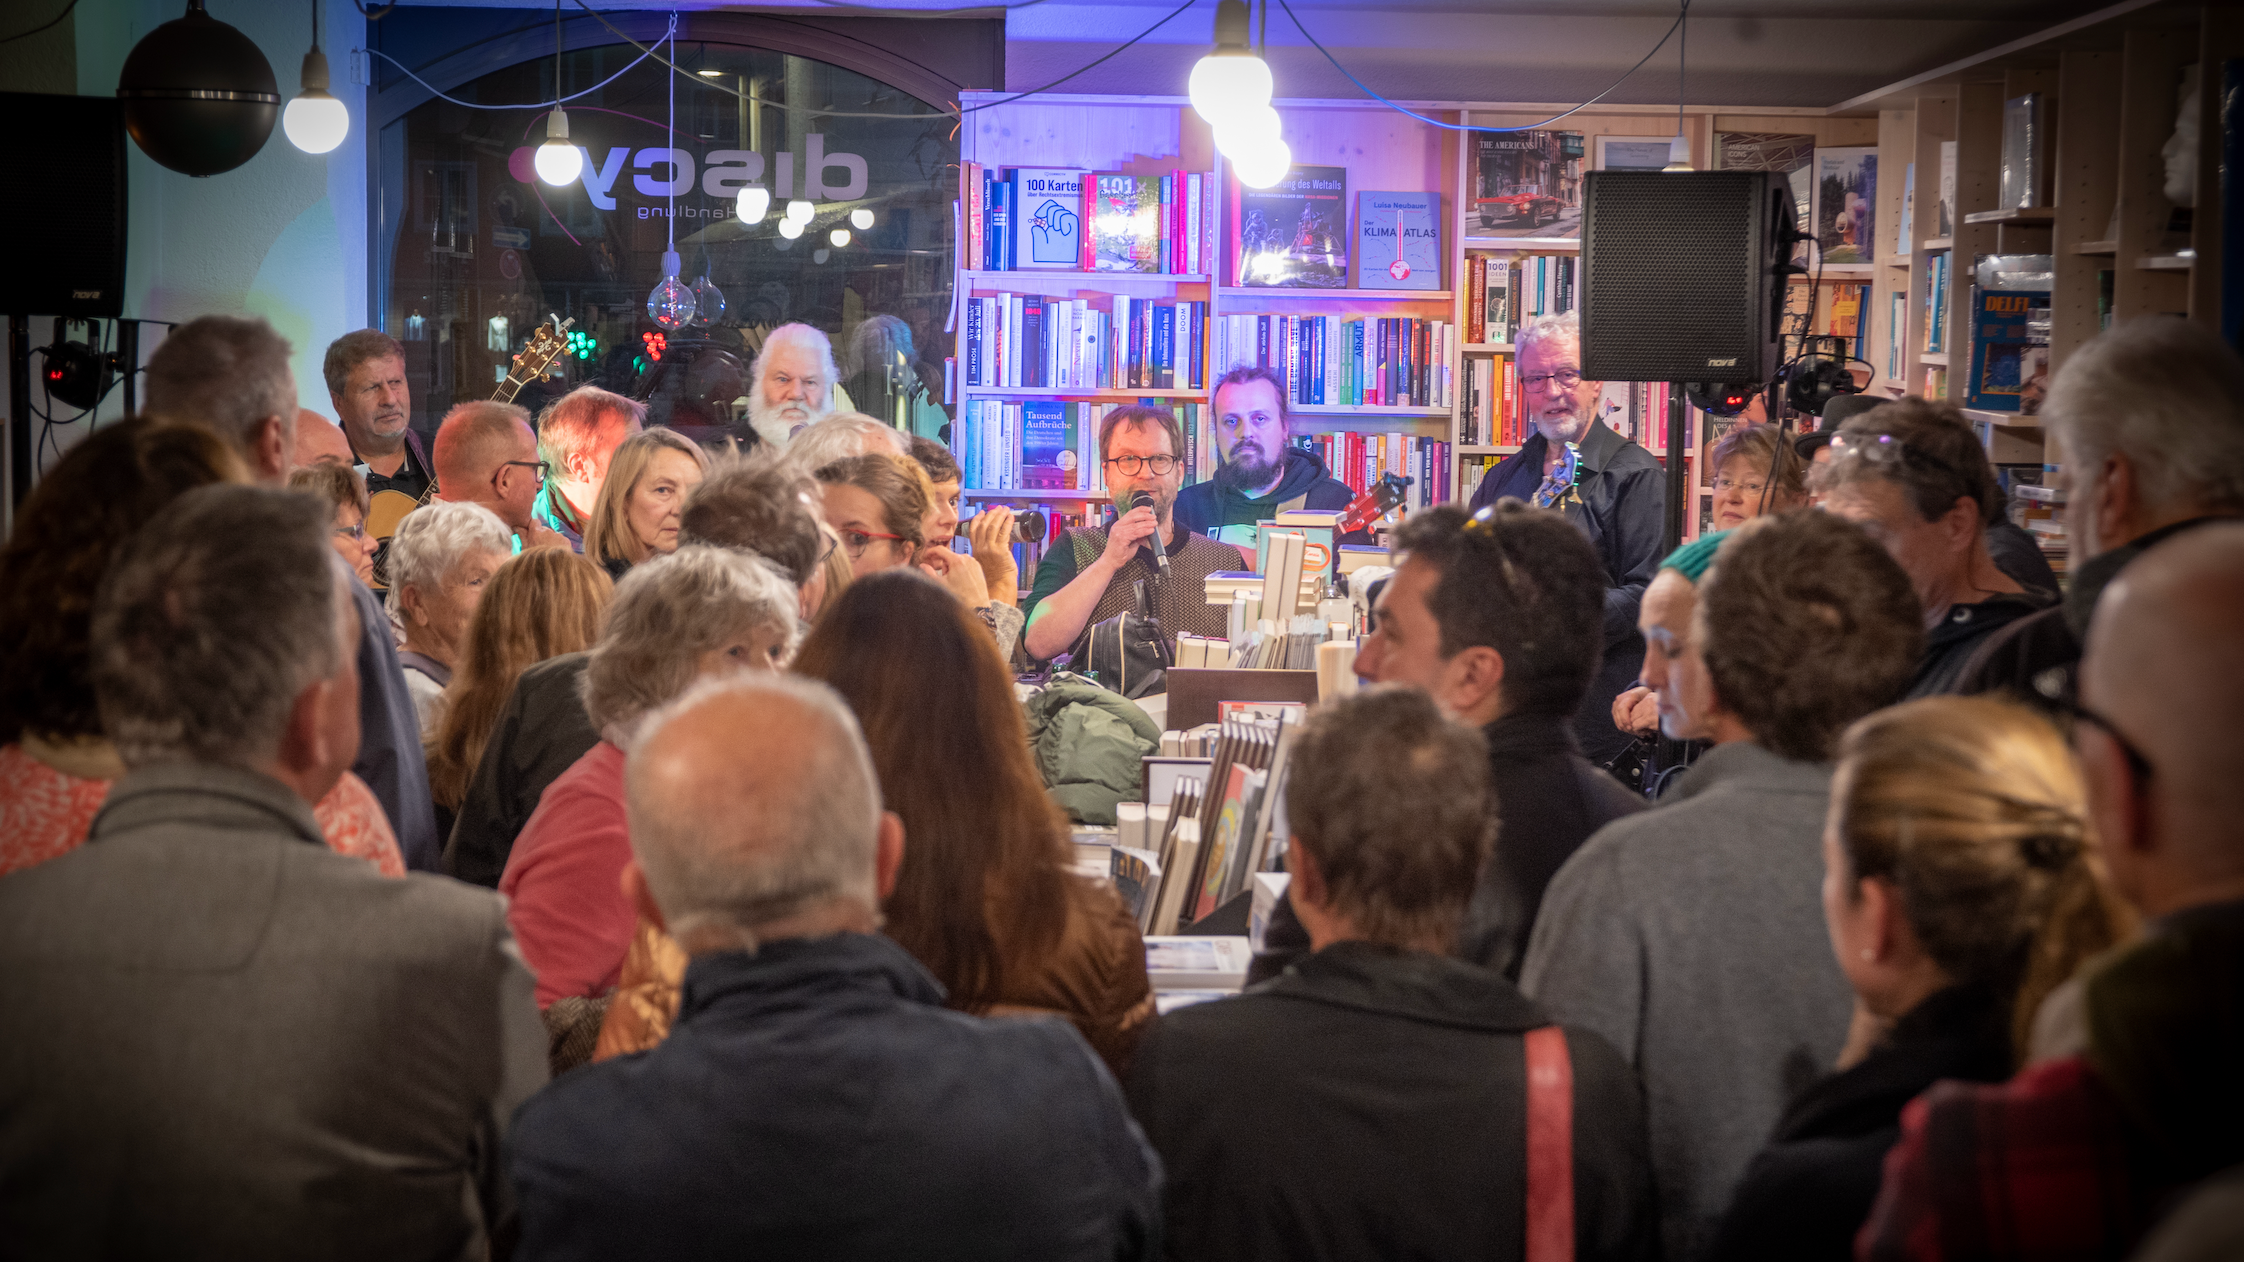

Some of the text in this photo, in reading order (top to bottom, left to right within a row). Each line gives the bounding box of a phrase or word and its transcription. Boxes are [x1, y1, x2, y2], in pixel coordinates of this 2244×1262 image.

[1479, 141, 1535, 150] THE AMERICANS
[1026, 179, 1083, 192] 100 Karten
[1100, 177, 1133, 195] 101
[1298, 179, 1311, 189] des
[1312, 179, 1342, 191] Weltalls
[1393, 202, 1427, 210] Neubauer
[1364, 227, 1437, 238] KLIMA ATLAS
[1488, 263, 1508, 271] 1001
[72, 290, 101, 299] nova
[1355, 324, 1363, 358] ARMUT
[1708, 358, 1736, 367] nova
[1026, 411, 1063, 420] Tausend
[1026, 420, 1072, 429] Aufbrüche
